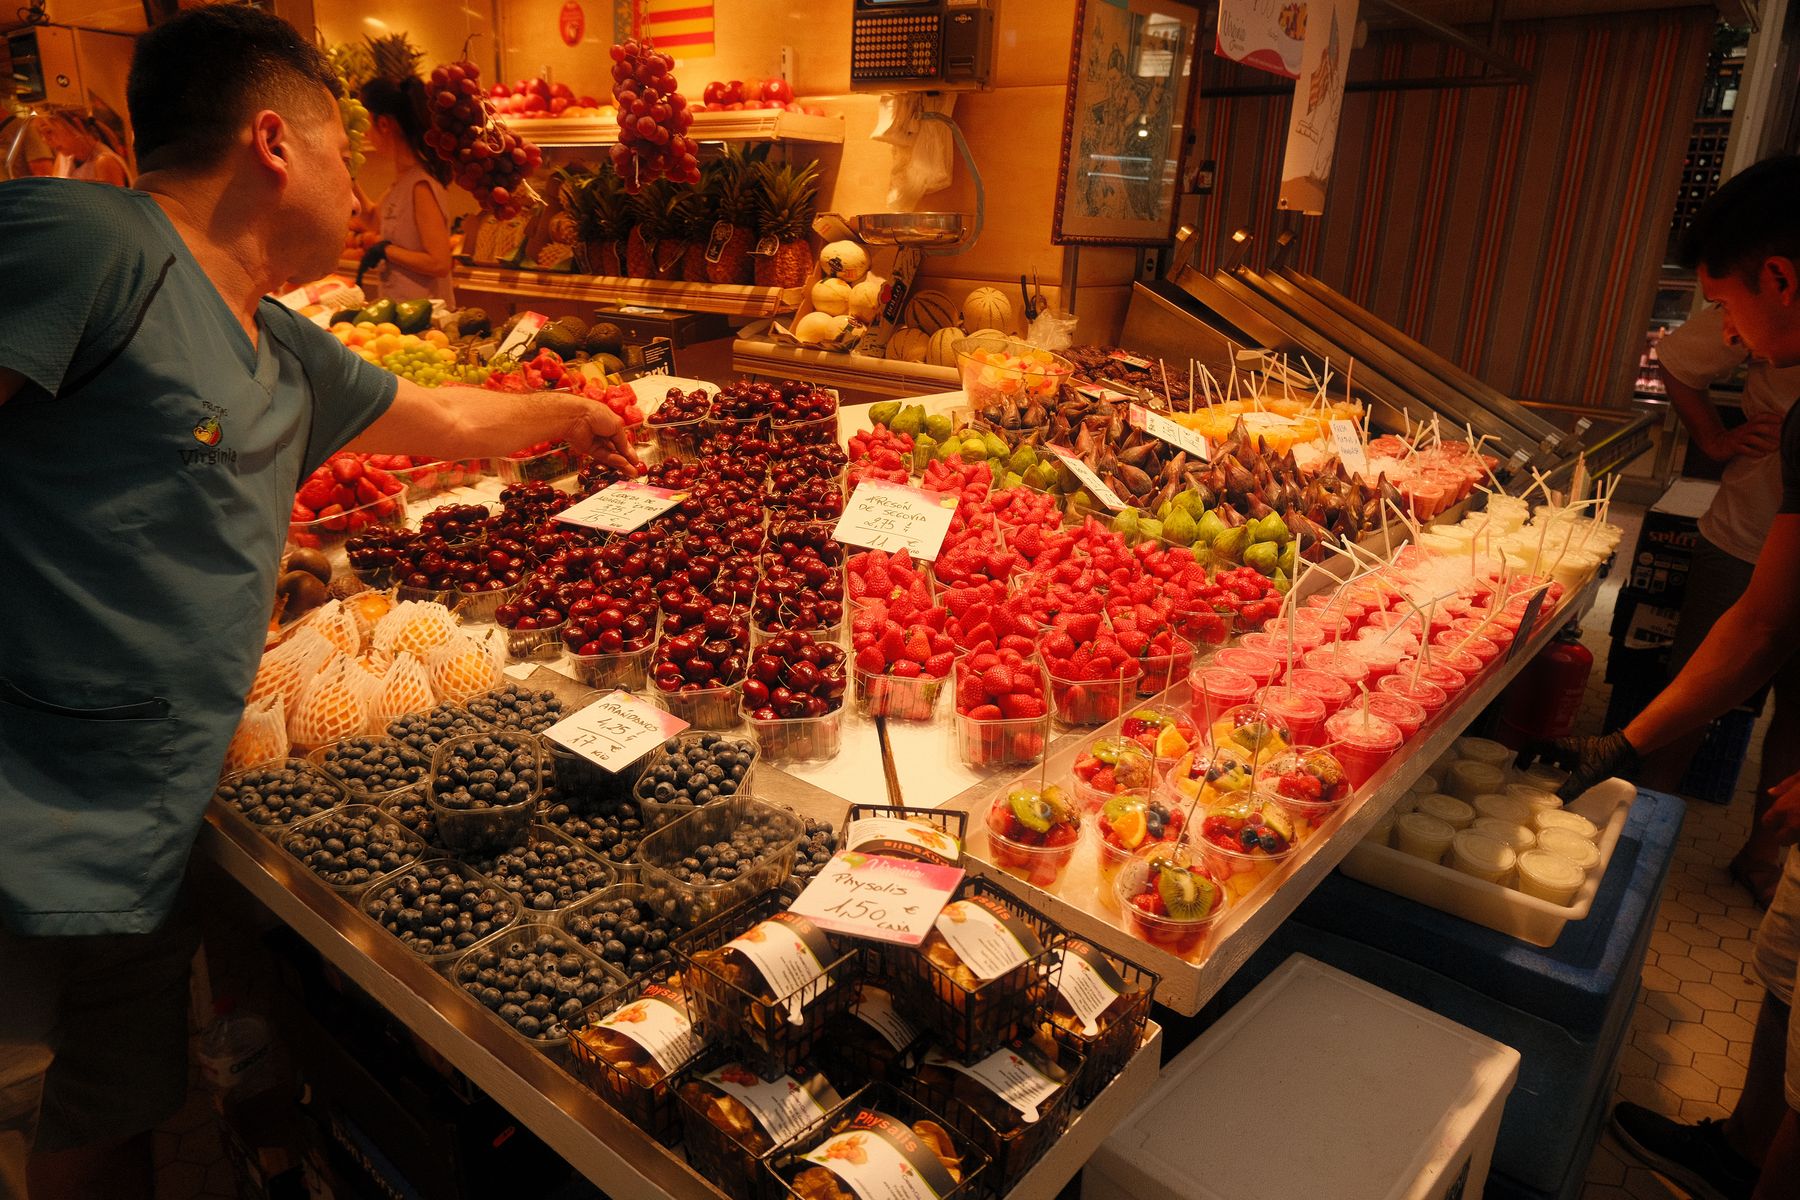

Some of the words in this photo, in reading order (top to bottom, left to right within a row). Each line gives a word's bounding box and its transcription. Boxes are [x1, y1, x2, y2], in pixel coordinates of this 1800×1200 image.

[202, 401, 228, 416] FRUTAS
[177, 448, 237, 465] Virginia
[865, 495, 912, 511] FRESÓN
[859, 503, 873, 512] DE
[883, 509, 926, 522] SEGOVIA
[866, 534, 889, 547] 11
[567, 733, 598, 747] 17
[832, 872, 908, 896] Physalis
[824, 898, 887, 921] 1,50
[903, 905, 920, 916] €
[852, 1111, 918, 1153] Physalis
